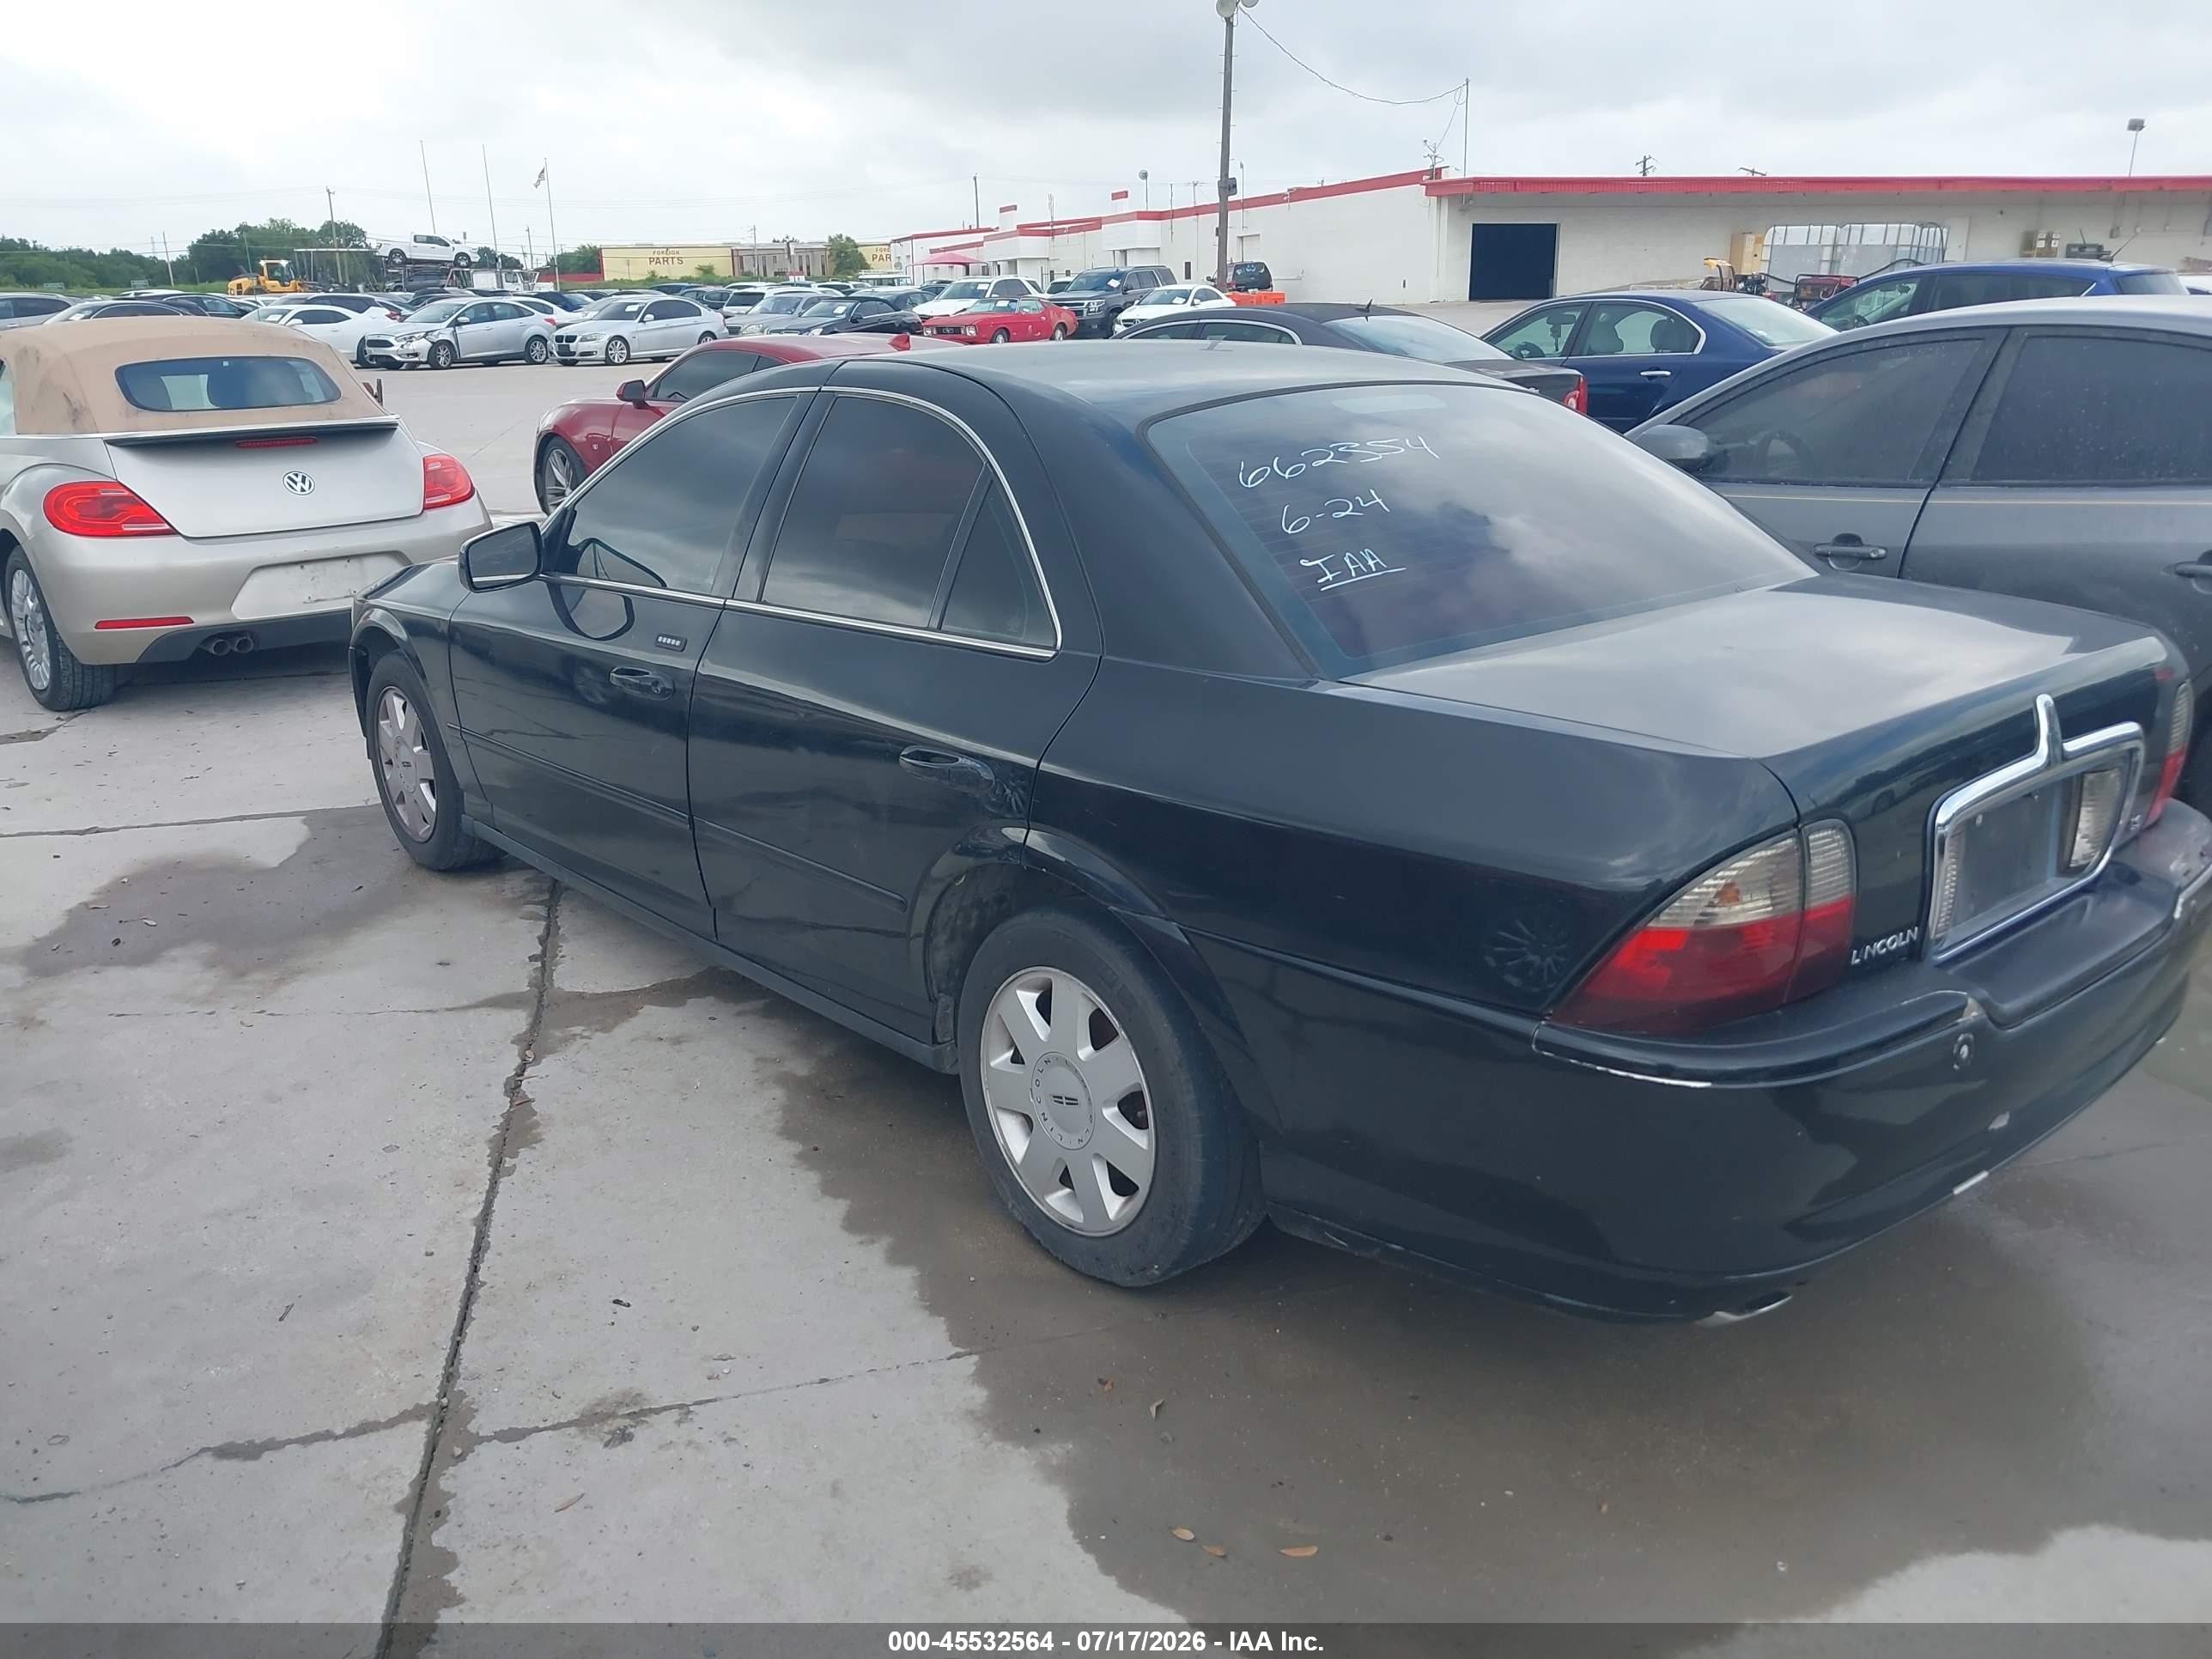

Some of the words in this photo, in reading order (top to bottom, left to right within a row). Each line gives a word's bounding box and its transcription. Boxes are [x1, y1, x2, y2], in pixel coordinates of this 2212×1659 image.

[648, 257, 684, 265] PARTS
[1238, 434, 1441, 489] 662354
[1280, 488, 1390, 534] 6-24
[1299, 548, 1388, 584] IAA
[1850, 927, 1919, 966] LINCOLN
